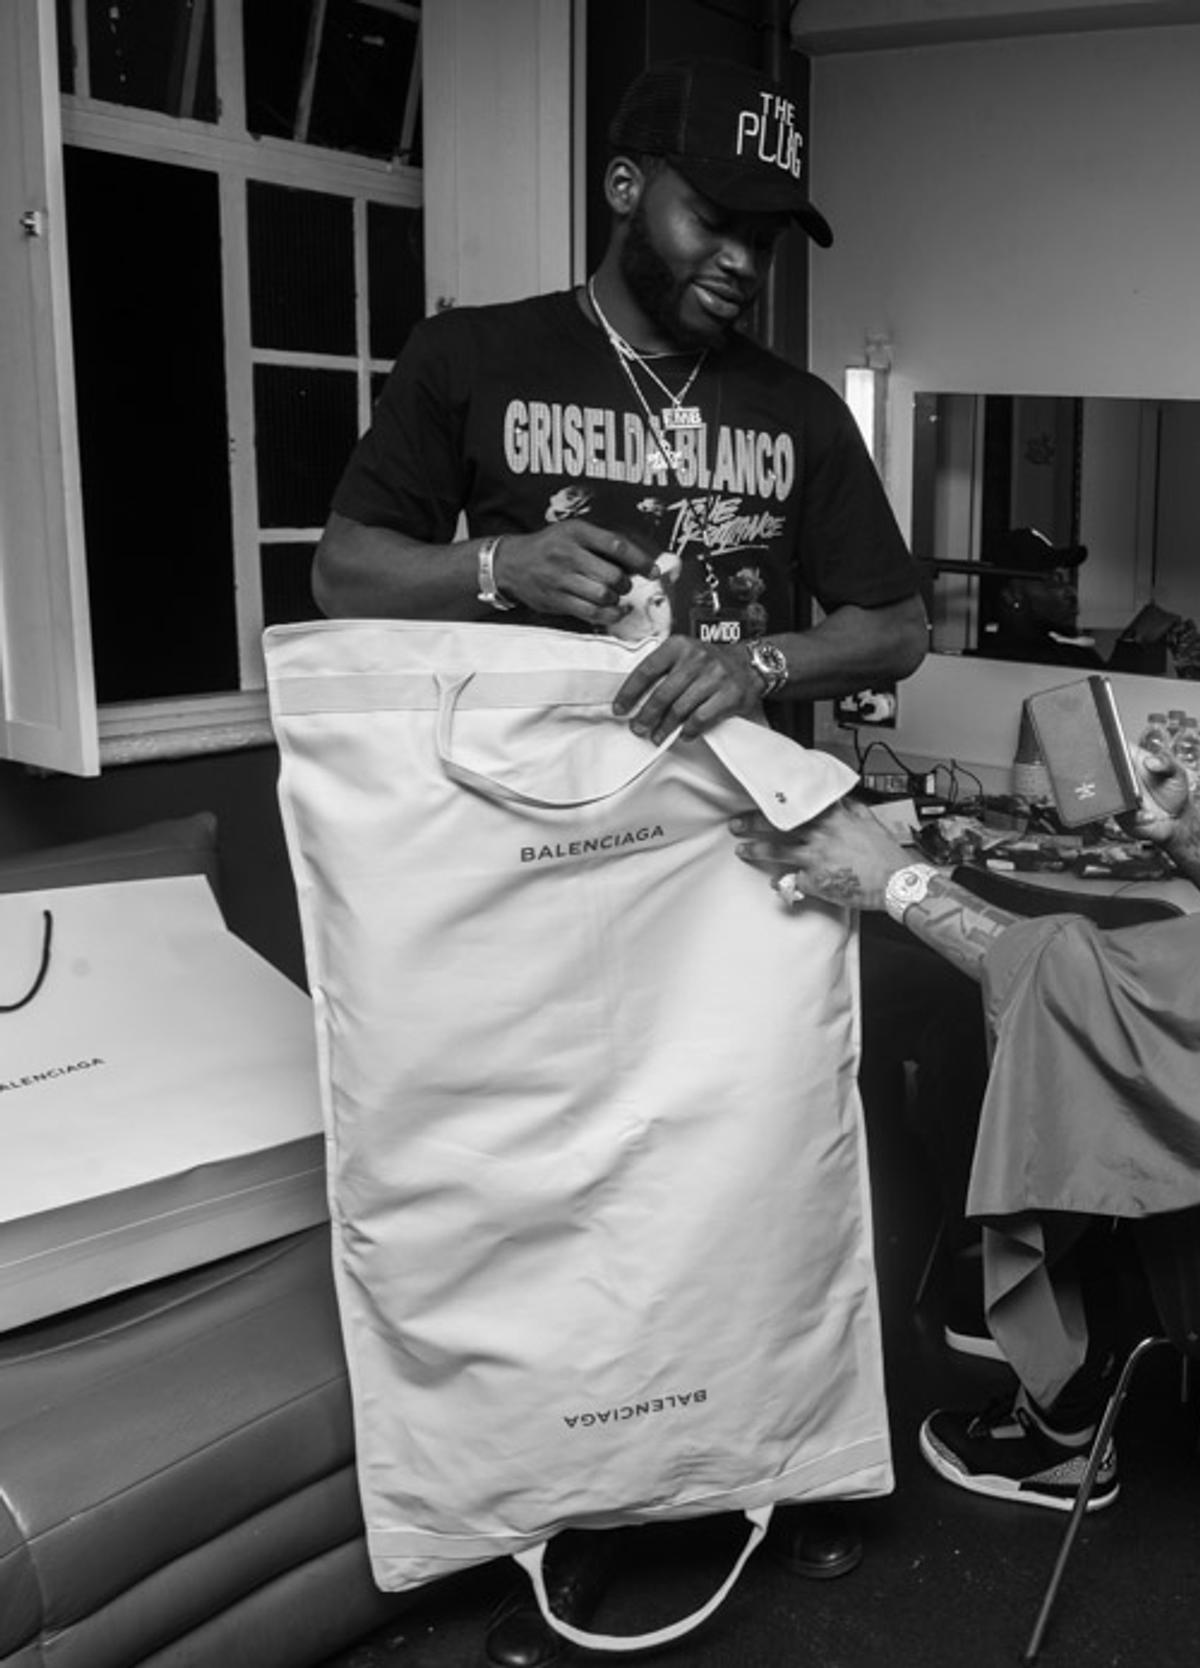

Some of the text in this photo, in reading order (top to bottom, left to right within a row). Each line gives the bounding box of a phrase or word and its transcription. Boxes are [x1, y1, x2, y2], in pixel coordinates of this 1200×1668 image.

[760, 91, 796, 127] THE
[736, 110, 803, 179] PLUG
[504, 399, 795, 501] GRISELDA BLANCO
[520, 825, 665, 863] BALENCIAGA
[563, 1388, 708, 1429] BALENCIAGA
